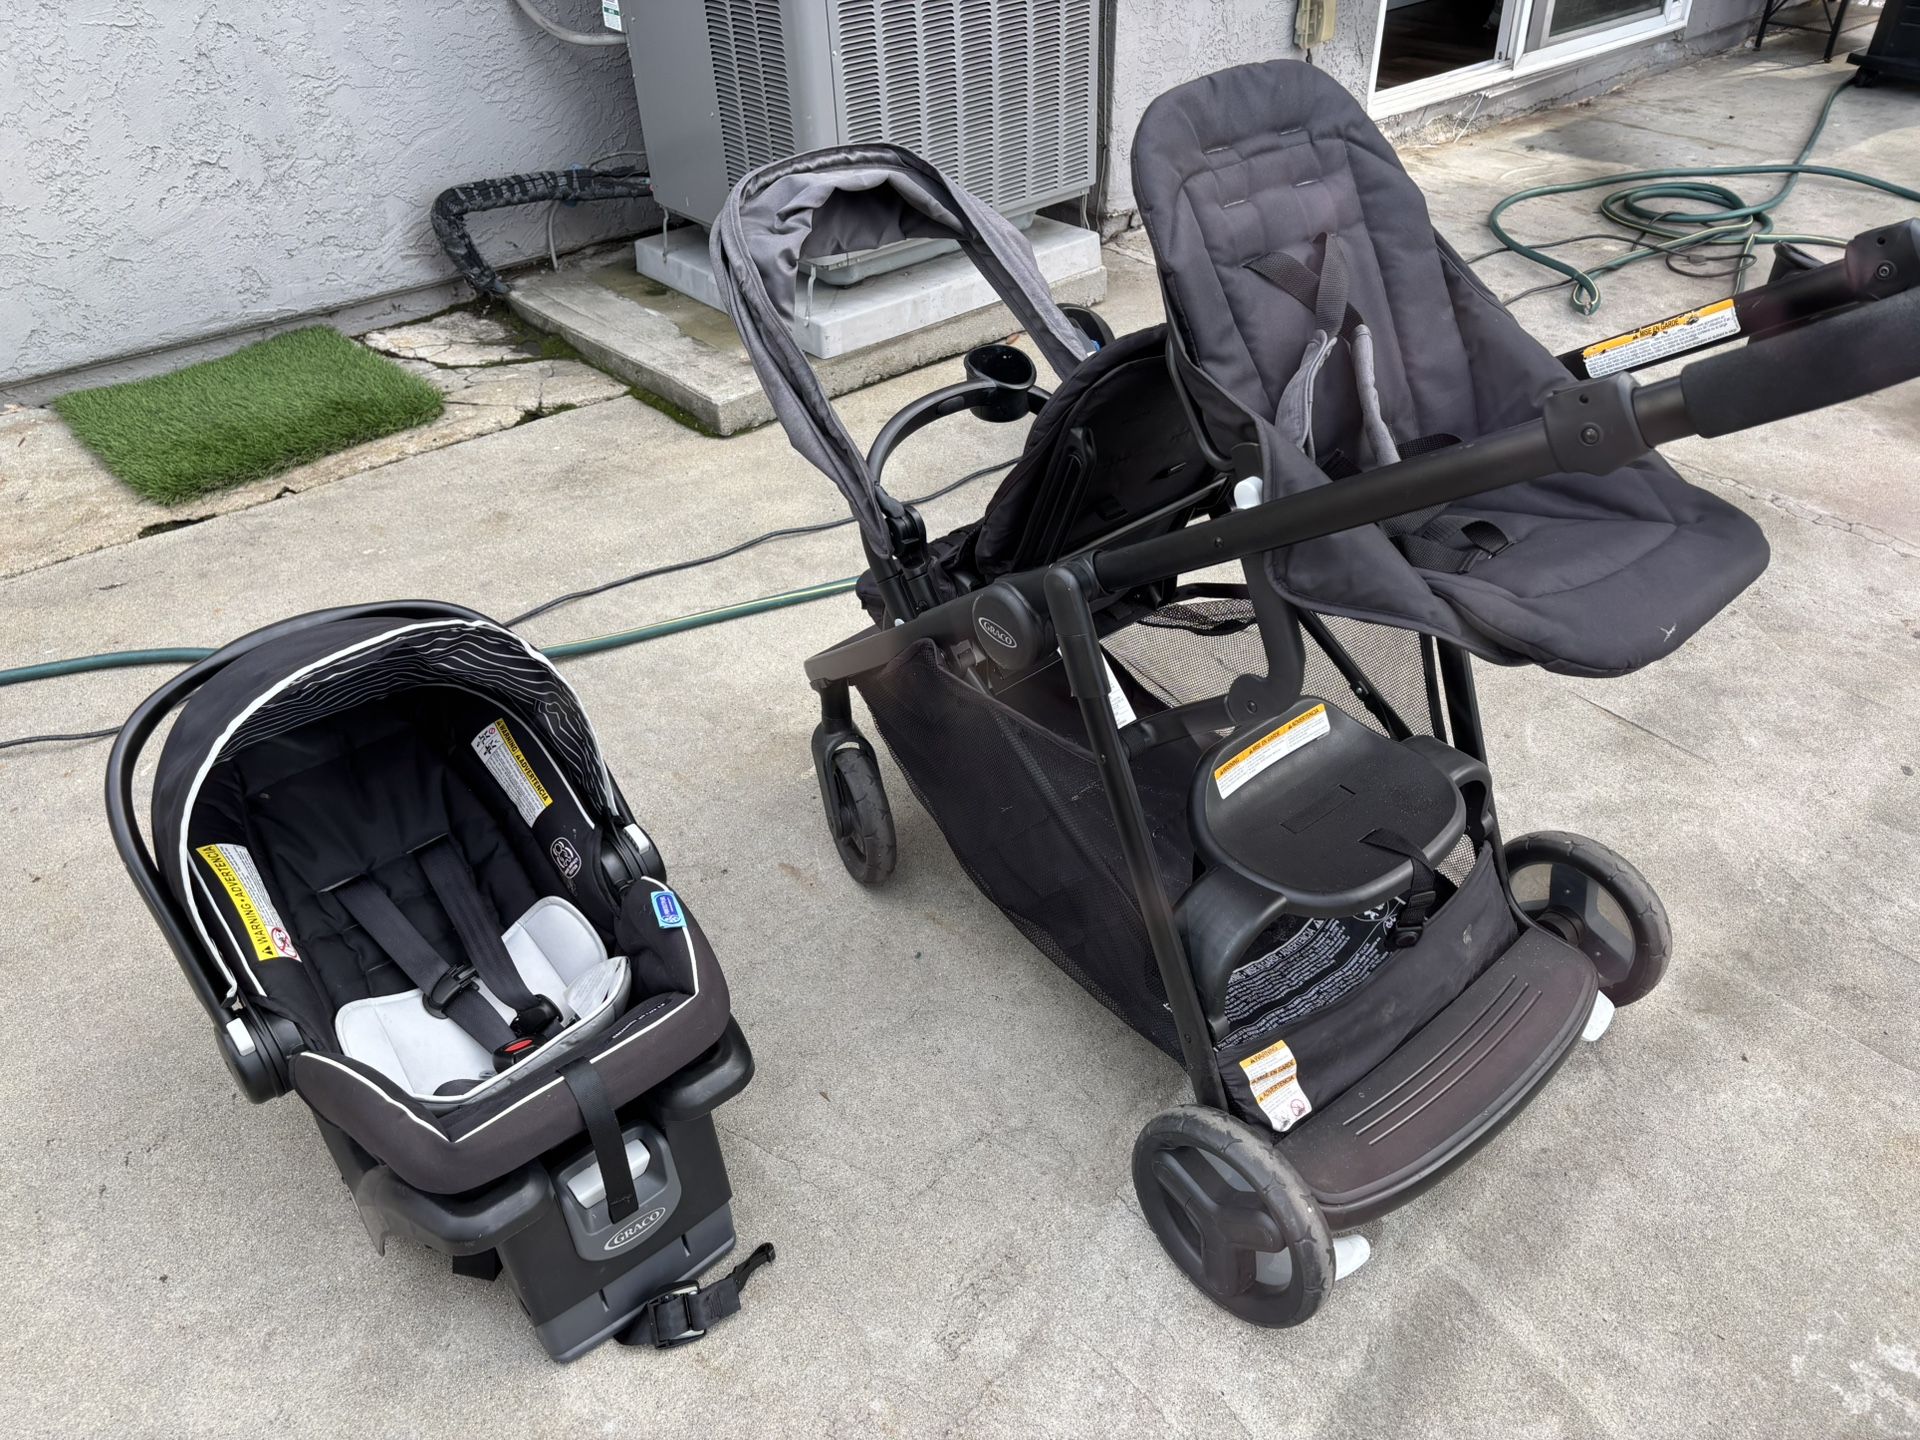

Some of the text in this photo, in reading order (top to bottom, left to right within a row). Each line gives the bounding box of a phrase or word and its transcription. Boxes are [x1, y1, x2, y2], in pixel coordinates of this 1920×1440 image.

[1640, 328, 1652, 337] MISE
[1660, 319, 1679, 330] GARDE
[983, 621, 1012, 645] GRACO
[498, 724, 548, 802] WARNING ADVERTENCIA
[202, 846, 244, 898] ADVERTENCIA
[240, 903, 268, 946] WARNING
[1281, 929, 1315, 958] ADVERTENCIA
[613, 1210, 660, 1245] GRACO
